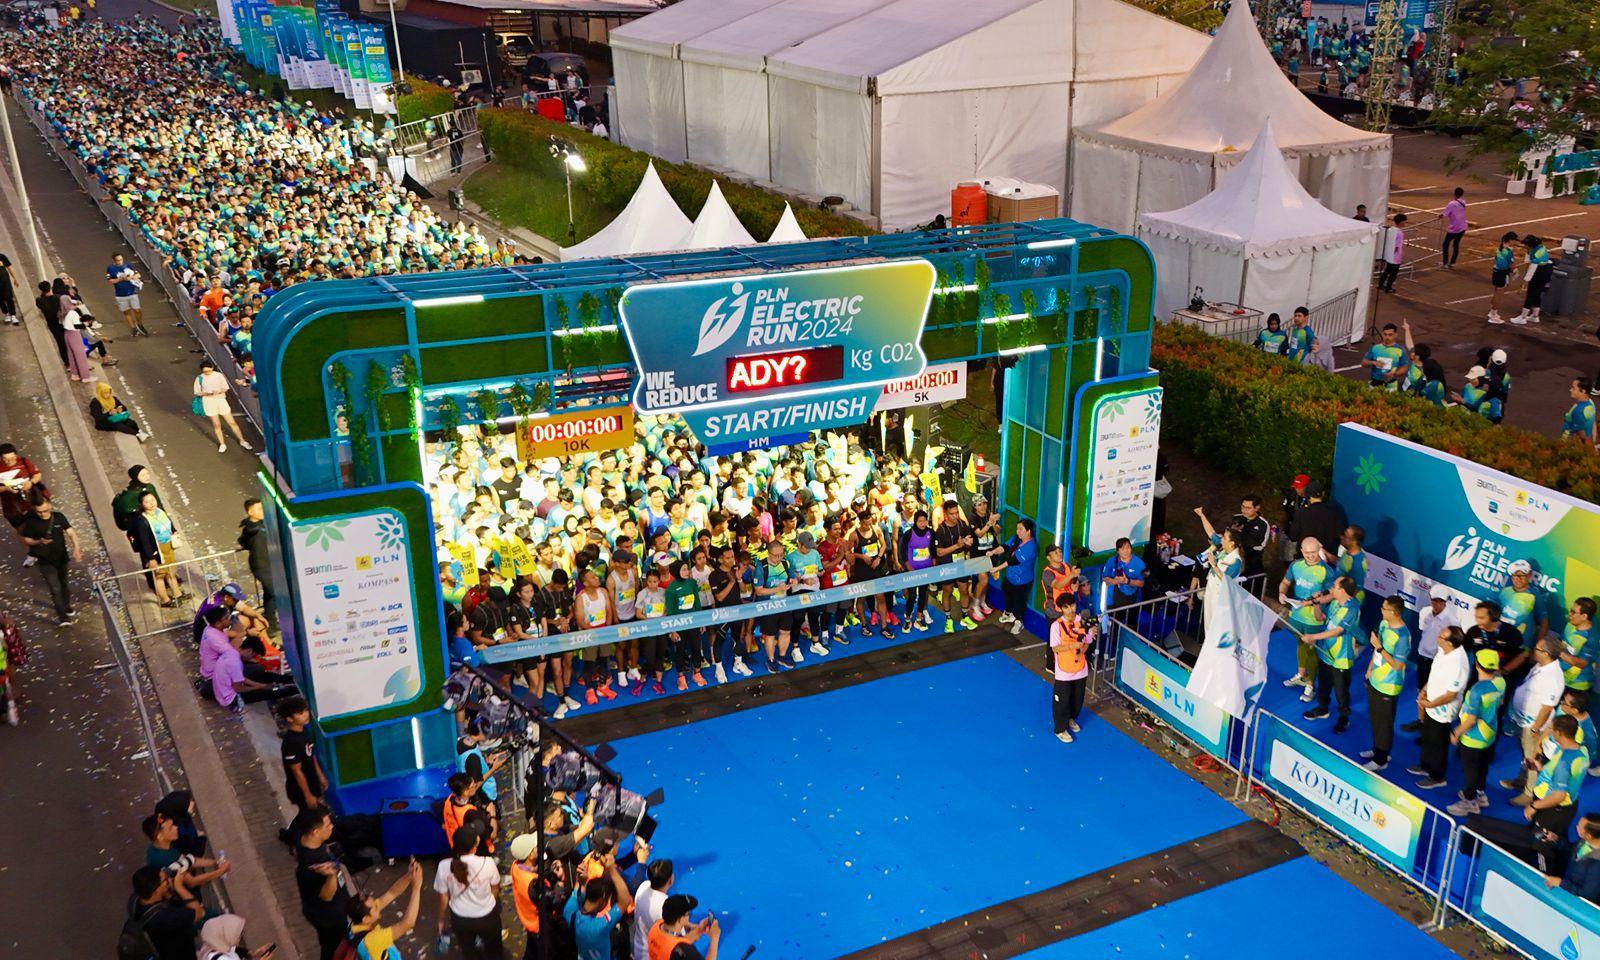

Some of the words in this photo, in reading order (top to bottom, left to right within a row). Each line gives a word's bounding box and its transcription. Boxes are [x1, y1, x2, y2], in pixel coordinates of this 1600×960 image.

[756, 287, 789, 303] PLN
[751, 295, 864, 324] ELECTRIC
[747, 321, 799, 347] RUN
[798, 316, 853, 342] 2024
[851, 349, 872, 371] Kg
[880, 343, 914, 365] CO2
[730, 355, 807, 389] ADY?
[646, 371, 675, 391] WE
[646, 382, 718, 409] REDUCE
[914, 391, 929, 403] 5K
[704, 397, 867, 438] START/FINISH
[532, 416, 617, 443] 00:00:00
[564, 439, 590, 452] 10K
[748, 436, 769, 449] HM
[1528, 497, 1549, 511] PLN
[1482, 539, 1507, 556] PLN
[373, 554, 399, 565] PLN
[1471, 562, 1509, 587] RUN
[1476, 549, 1560, 592] ELERIC
[848, 584, 867, 595] 10K
[387, 603, 403, 611] BCA
[756, 599, 788, 612] START
[1454, 598, 1470, 610] BCA
[629, 625, 648, 634] PLN
[661, 616, 693, 630] START
[569, 633, 592, 646] 10K
[1163, 686, 1196, 717] PLN
[1290, 760, 1373, 823] KOMPAS
